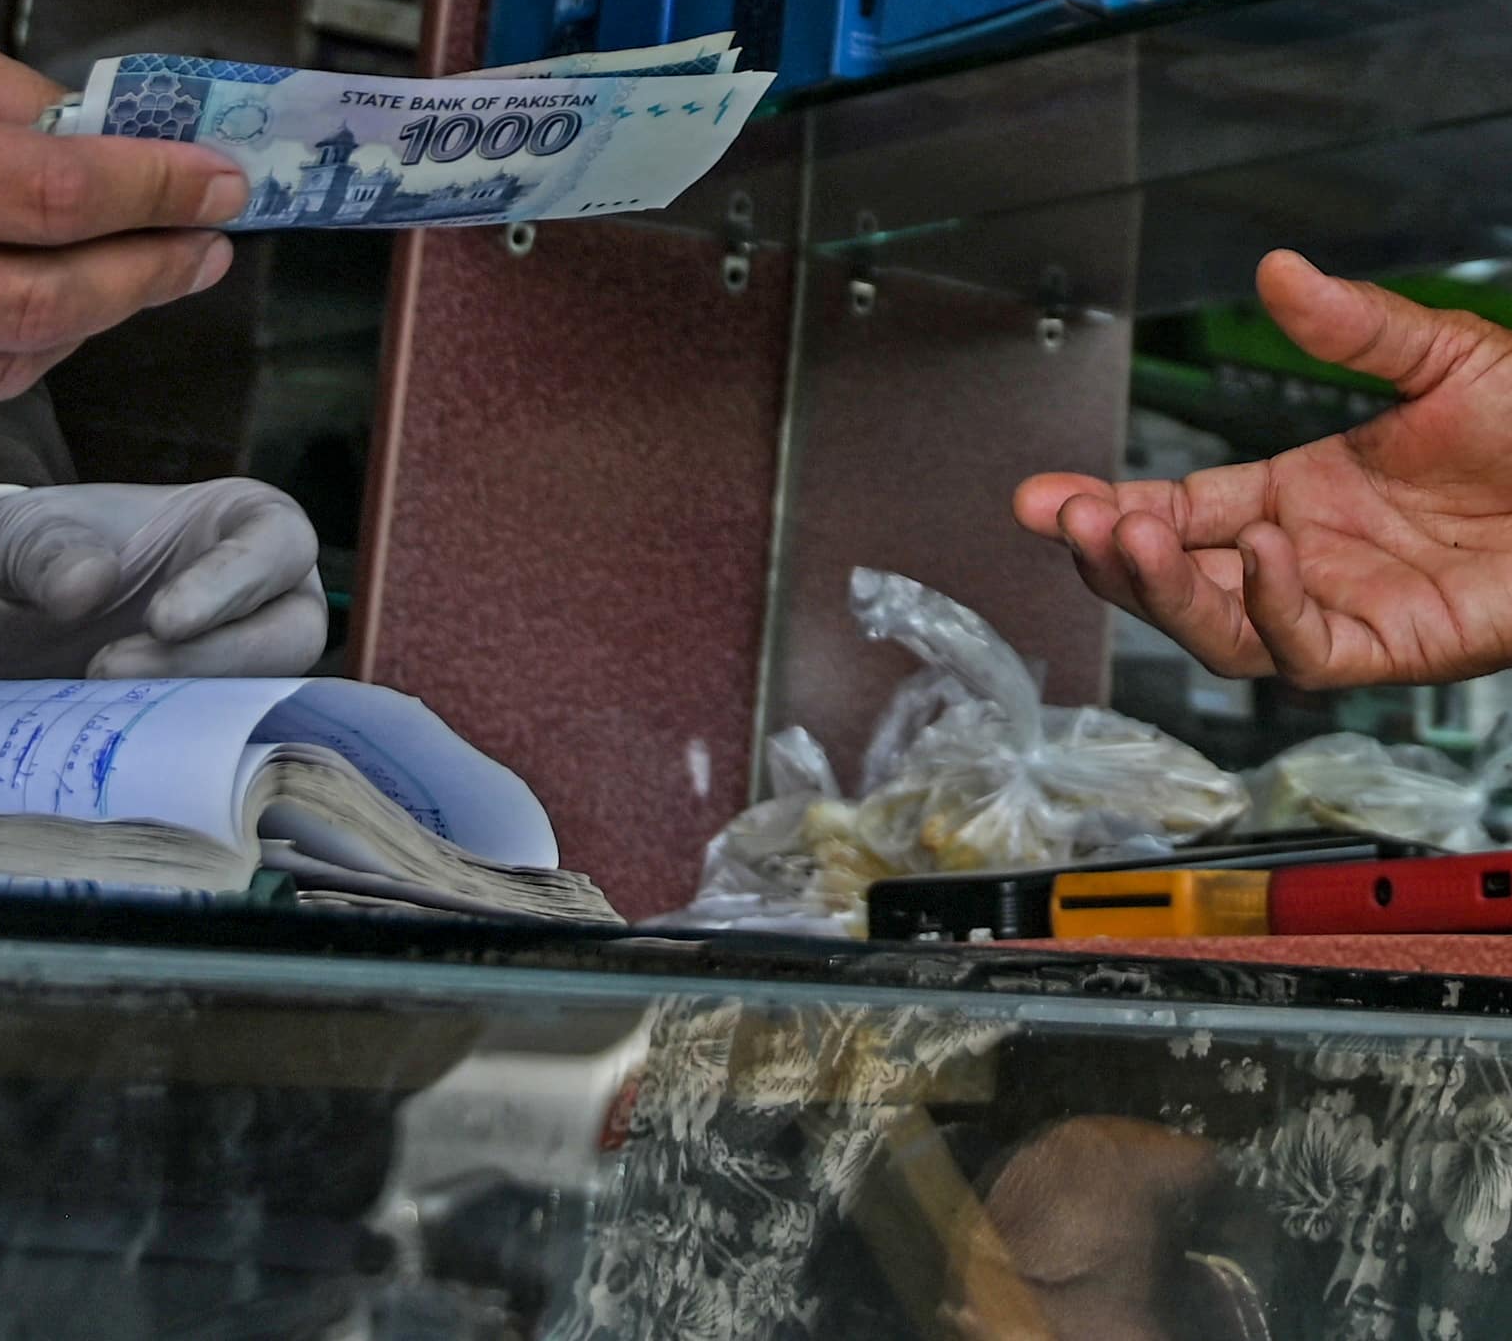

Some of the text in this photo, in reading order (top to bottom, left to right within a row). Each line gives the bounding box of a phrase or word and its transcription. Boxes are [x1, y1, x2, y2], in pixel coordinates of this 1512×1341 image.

[340, 90, 598, 111] STATE BANK OF PAKISTAN
[399, 109, 583, 166] 1000
